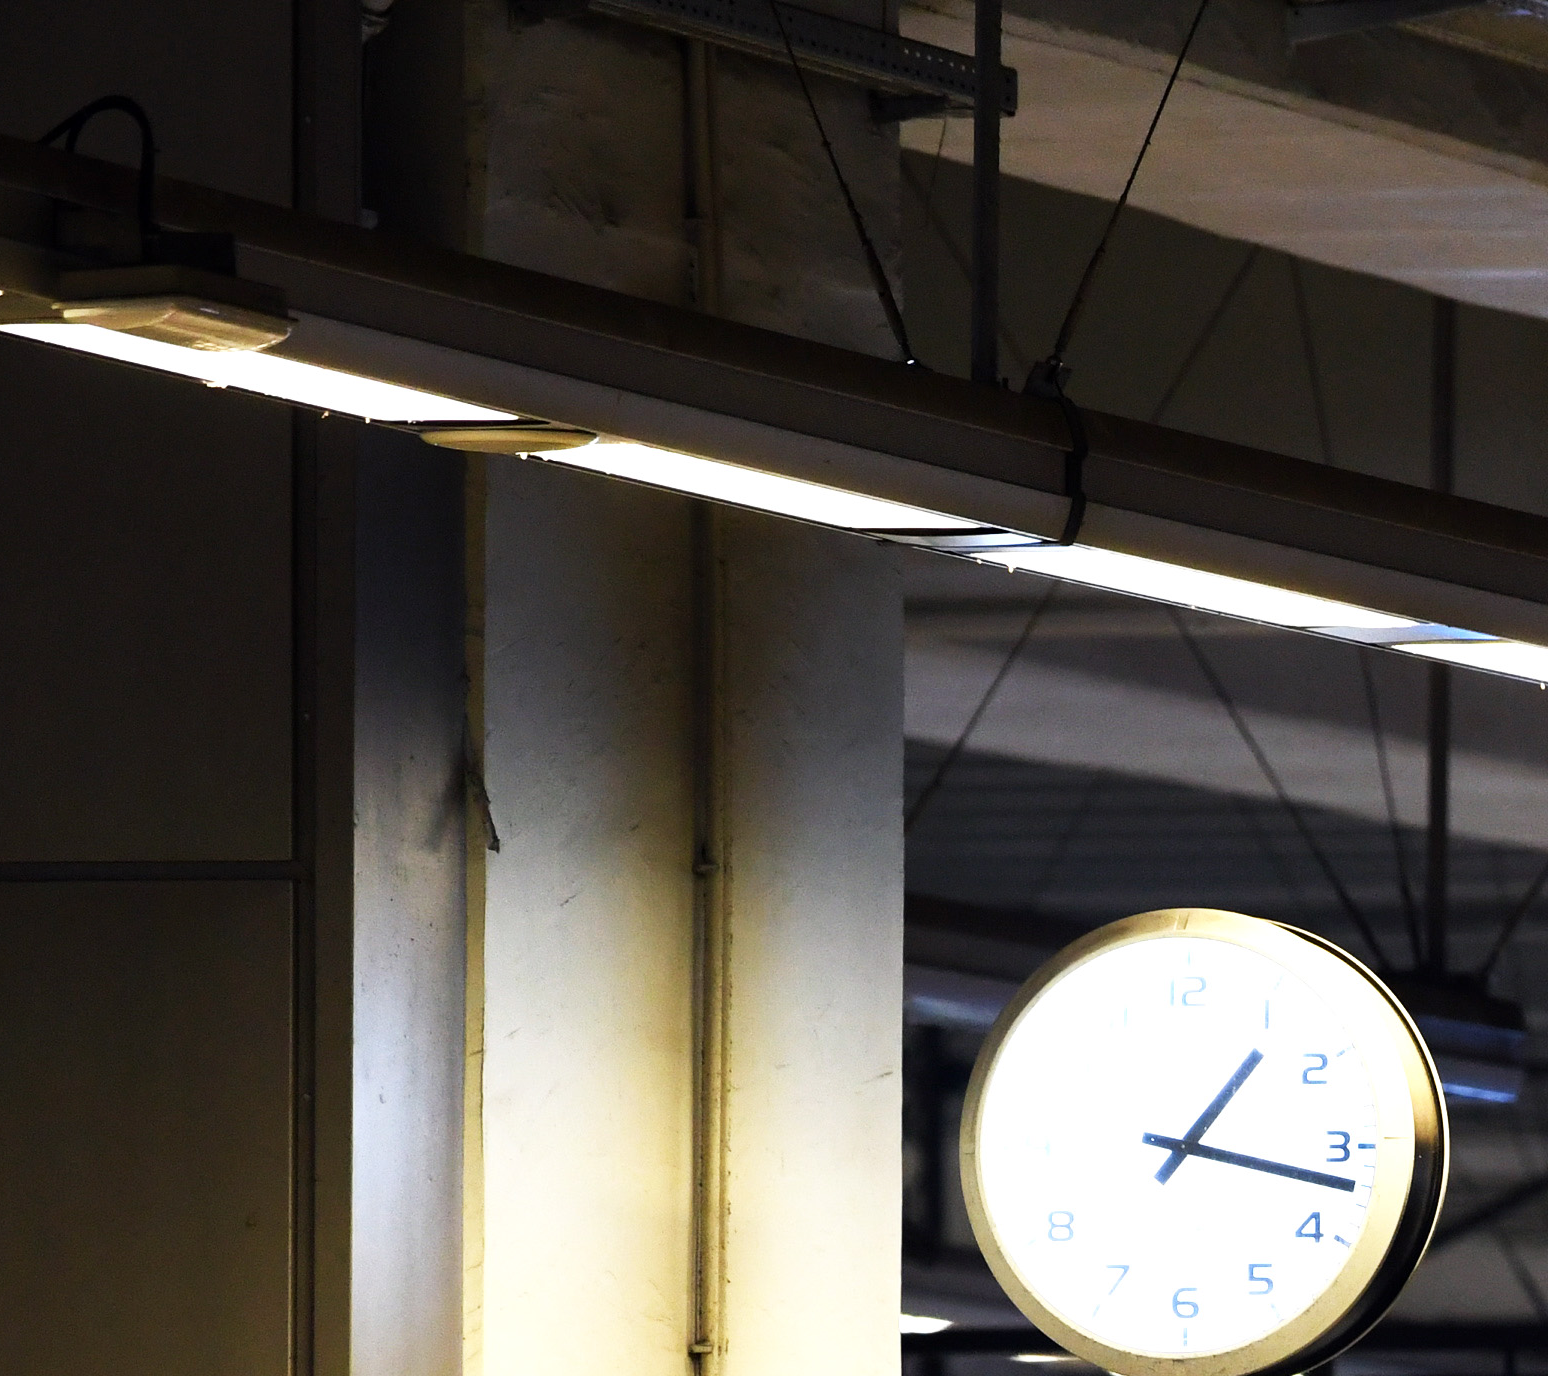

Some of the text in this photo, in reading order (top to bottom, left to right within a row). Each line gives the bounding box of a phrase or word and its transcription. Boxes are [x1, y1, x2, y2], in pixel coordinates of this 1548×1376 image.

[1170, 975, 1208, 1007] 12
[1301, 1052, 1329, 1085] 2
[1325, 1129, 1352, 1163] 3
[1047, 1210, 1075, 1242] 8
[1294, 1210, 1325, 1243] 4
[1105, 1263, 1131, 1296] 7
[1247, 1262, 1274, 1296] 5
[1171, 1286, 1200, 1319] 6
